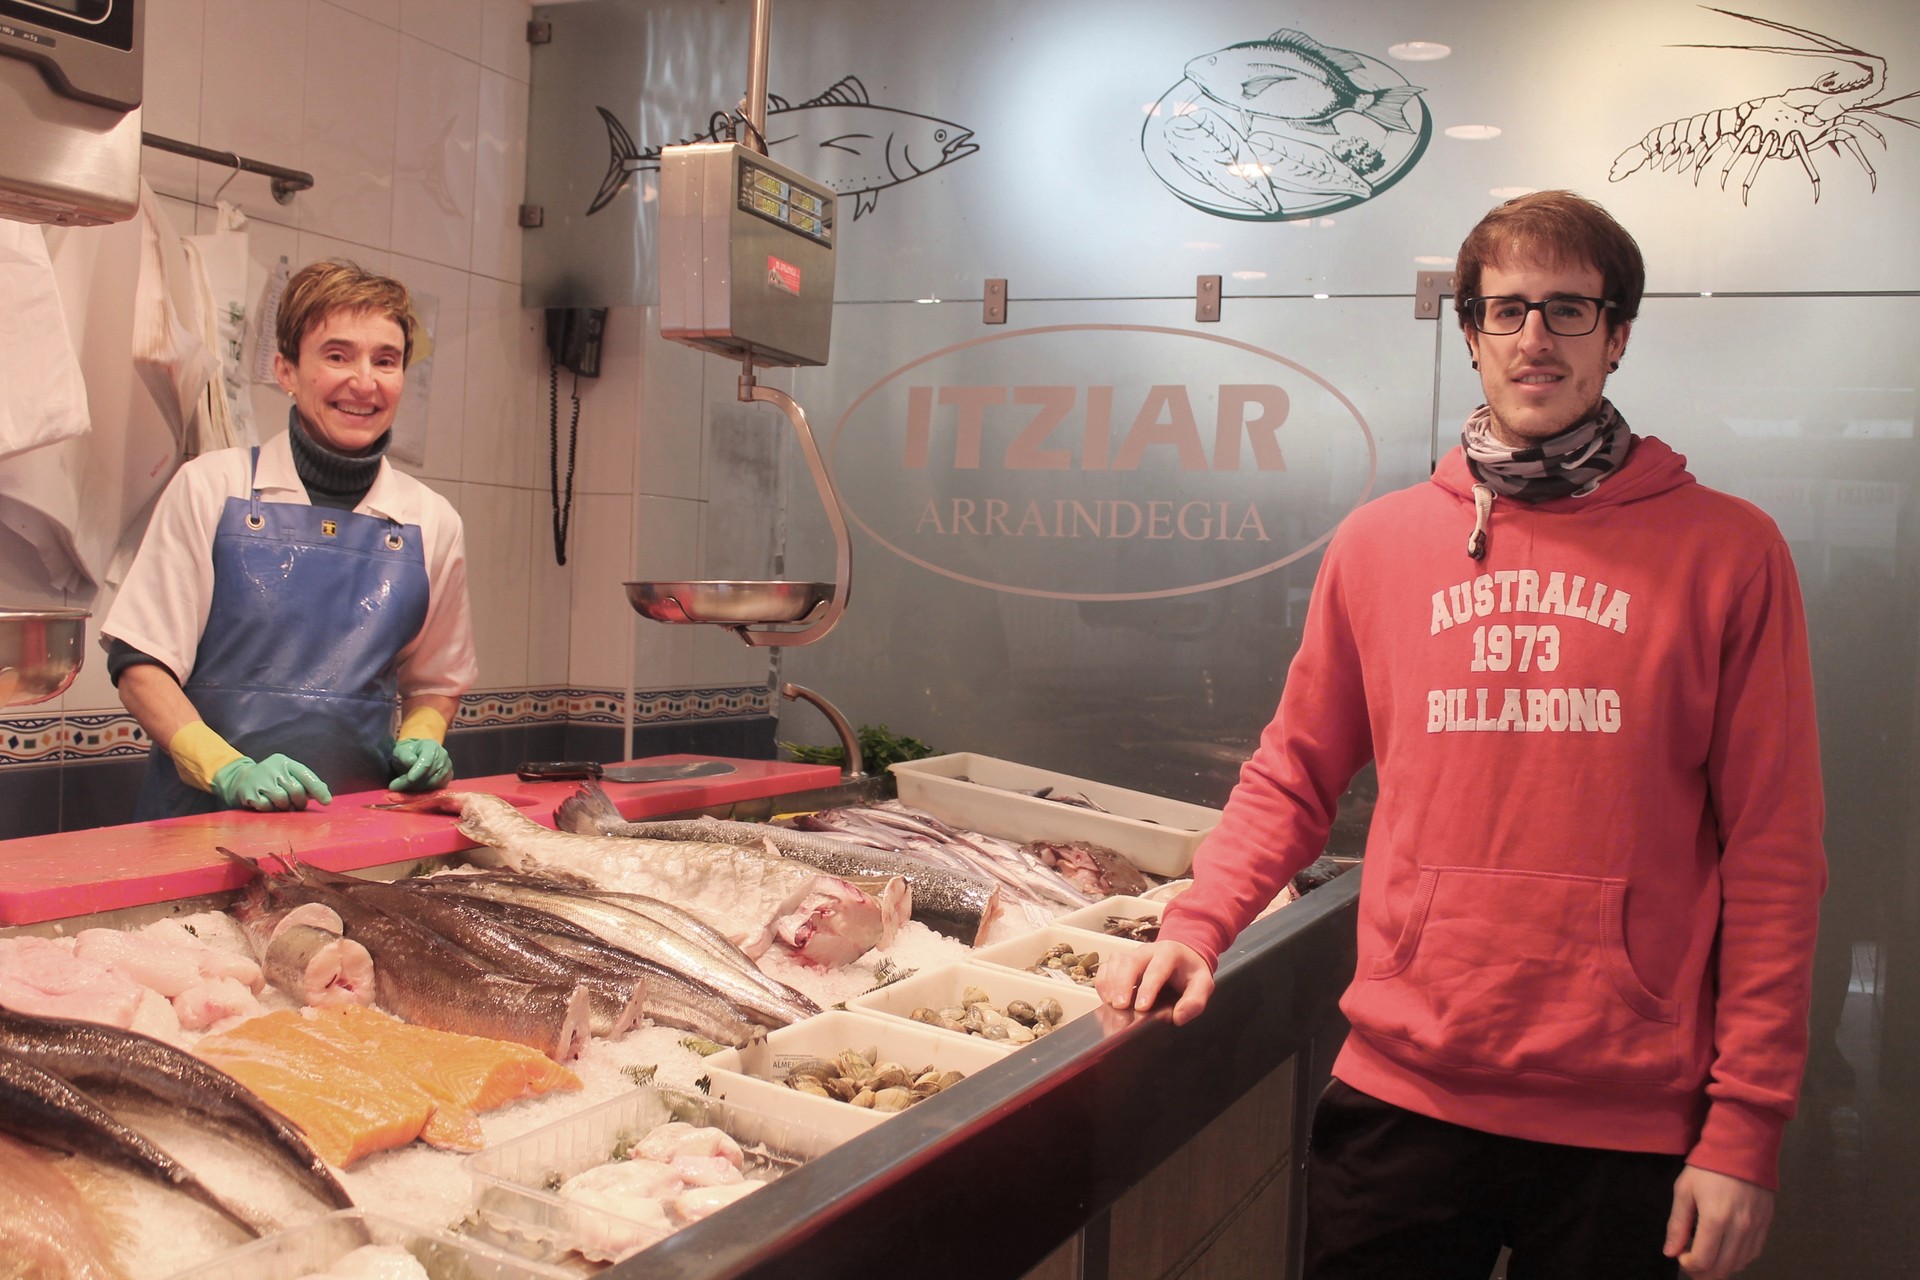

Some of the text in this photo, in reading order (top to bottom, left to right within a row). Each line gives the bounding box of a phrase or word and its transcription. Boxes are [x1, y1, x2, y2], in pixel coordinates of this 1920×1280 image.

[904, 384, 1291, 472] ITZIAR
[915, 498, 1272, 542] ARRAINDEGIA
[1430, 569, 1631, 637] AUSTRALIA
[1470, 624, 1561, 673] 1973
[1426, 688, 1622, 734] BILLABONG
